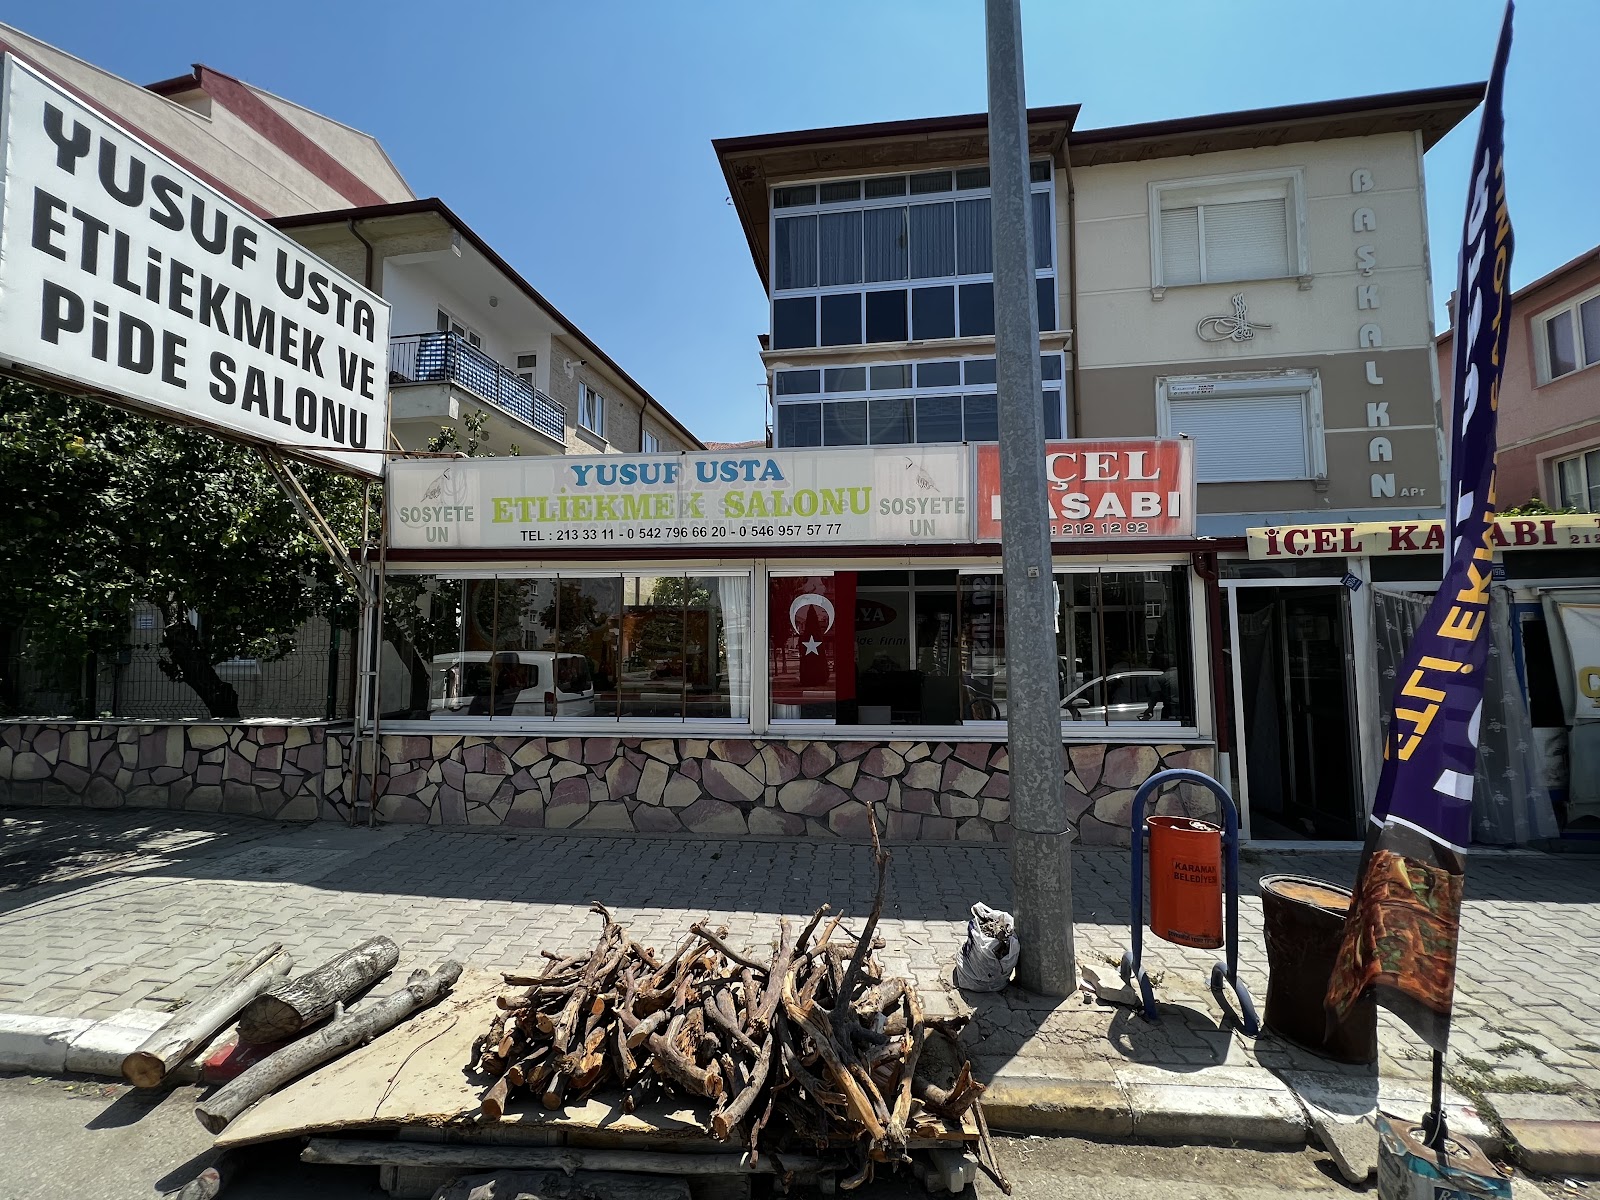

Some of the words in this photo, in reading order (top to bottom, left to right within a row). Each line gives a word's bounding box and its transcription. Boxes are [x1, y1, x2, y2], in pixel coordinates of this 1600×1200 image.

[43, 101, 258, 270] YUSUF
[275, 248, 376, 344] USTA
[31, 186, 325, 379] ETLİEKMEK
[338, 345, 375, 402] VE
[1351, 168, 1396, 498] BAŞKALKAN
[40, 279, 187, 390] PİDE
[209, 350, 368, 449] SALONU
[571, 462, 683, 486] YUSUF
[695, 459, 784, 483] USTA
[1046, 450, 1161, 491] ÇEL
[400, 506, 474, 523] SOSYETE
[491, 487, 705, 523] ETLİEKMEK
[724, 486, 873, 518] SALONU
[879, 496, 966, 516] SOSYETE
[991, 491, 1180, 520] SABI
[425, 526, 449, 543] UN
[521, 530, 545, 541] TEL
[556, 530, 579, 541] 213
[582, 529, 597, 540] 33
[601, 529, 614, 540] 11
[627, 528, 634, 539] 0
[639, 527, 661, 539] 542
[665, 527, 688, 538] 796
[692, 526, 707, 538] 66
[711, 525, 726, 537] 20
[739, 525, 746, 537] 0
[751, 525, 774, 537] 546
[778, 525, 802, 536] 957
[807, 524, 822, 536] 57
[826, 523, 842, 535] 77
[910, 519, 936, 537] UN
[1062, 523, 1095, 535] 212
[1101, 523, 1122, 534] 12
[1127, 522, 1149, 534] 92
[1266, 527, 1363, 556] İÇEL
[1388, 520, 1557, 551] KAABI
